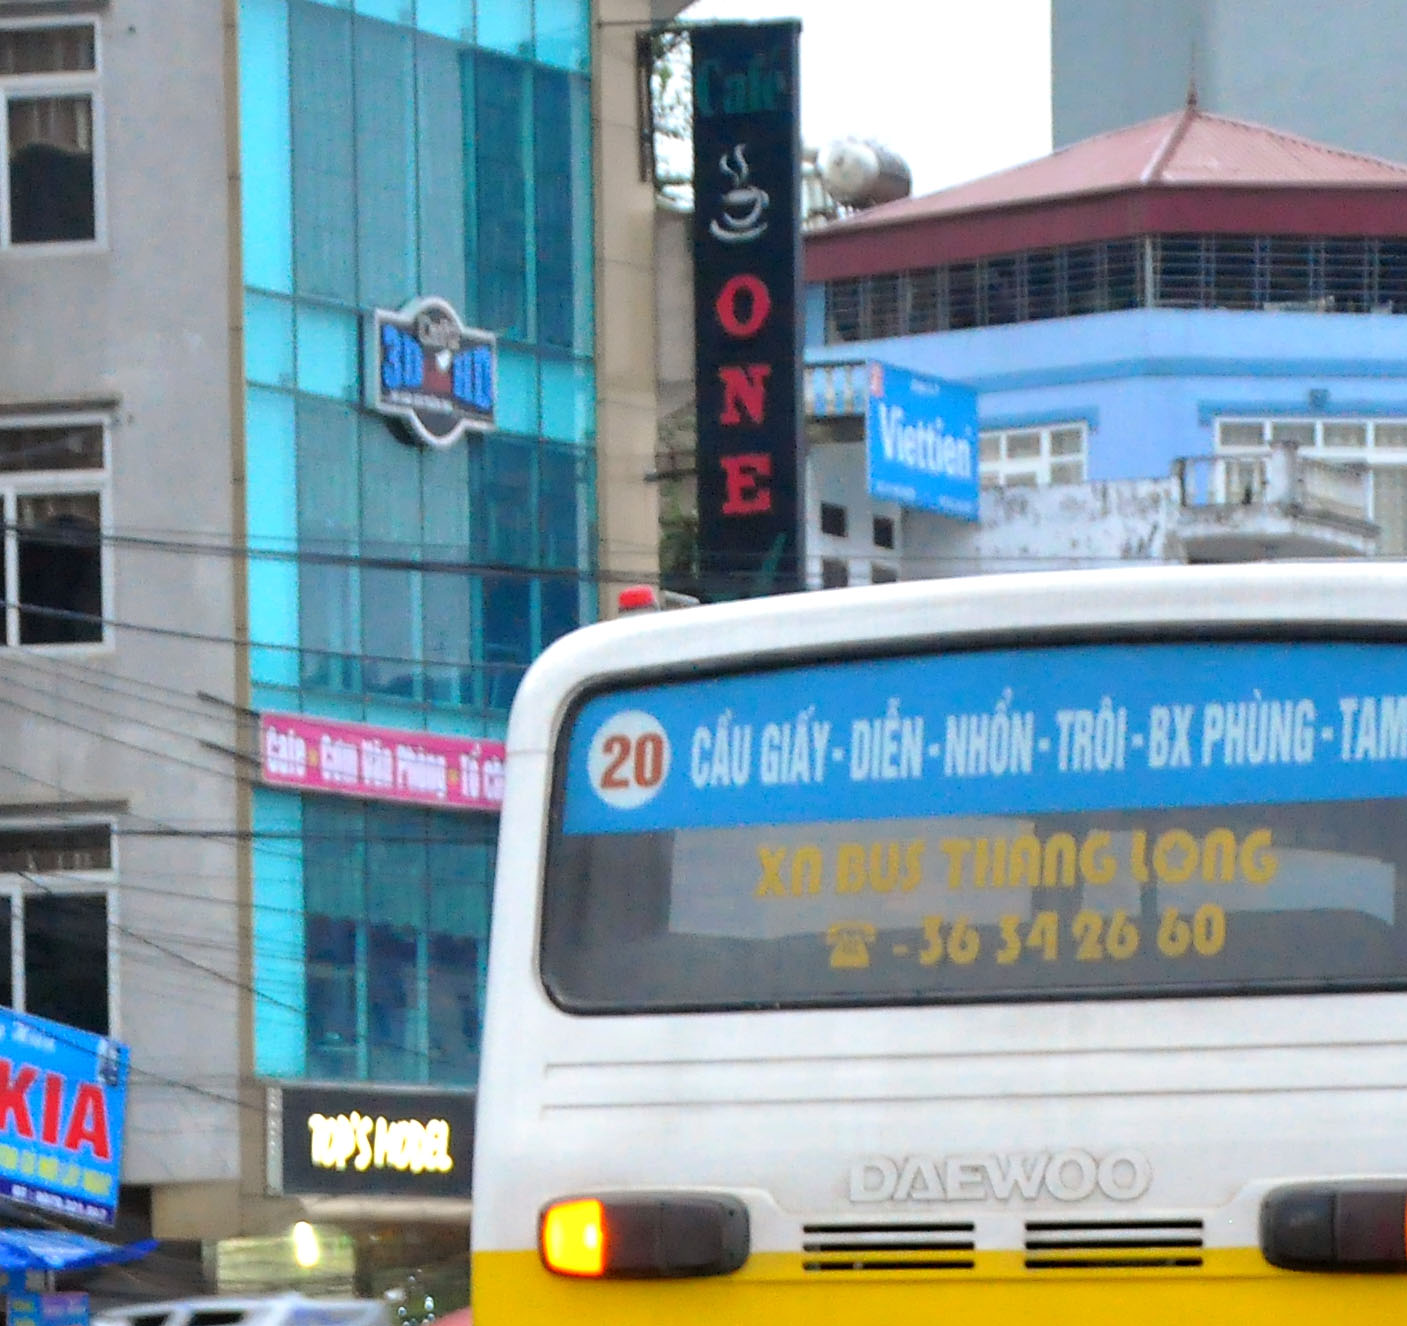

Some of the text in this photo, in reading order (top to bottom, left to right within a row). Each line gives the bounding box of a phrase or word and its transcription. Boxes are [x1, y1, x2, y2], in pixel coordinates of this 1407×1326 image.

[715, 273, 773, 515] ONE
[878, 402, 972, 479] Viettien
[600, 732, 665, 791] 20
[1056, 696, 1126, 772] TRÔI
[1147, 703, 1193, 769] BX
[1202, 687, 1316, 768] PHÙNG
[835, 840, 924, 896] BUS
[1129, 827, 1279, 886] LONG
[1072, 908, 1140, 962] 26
[1157, 903, 1227, 957] 60
[848, 1149, 1155, 1203] DAEWOO
